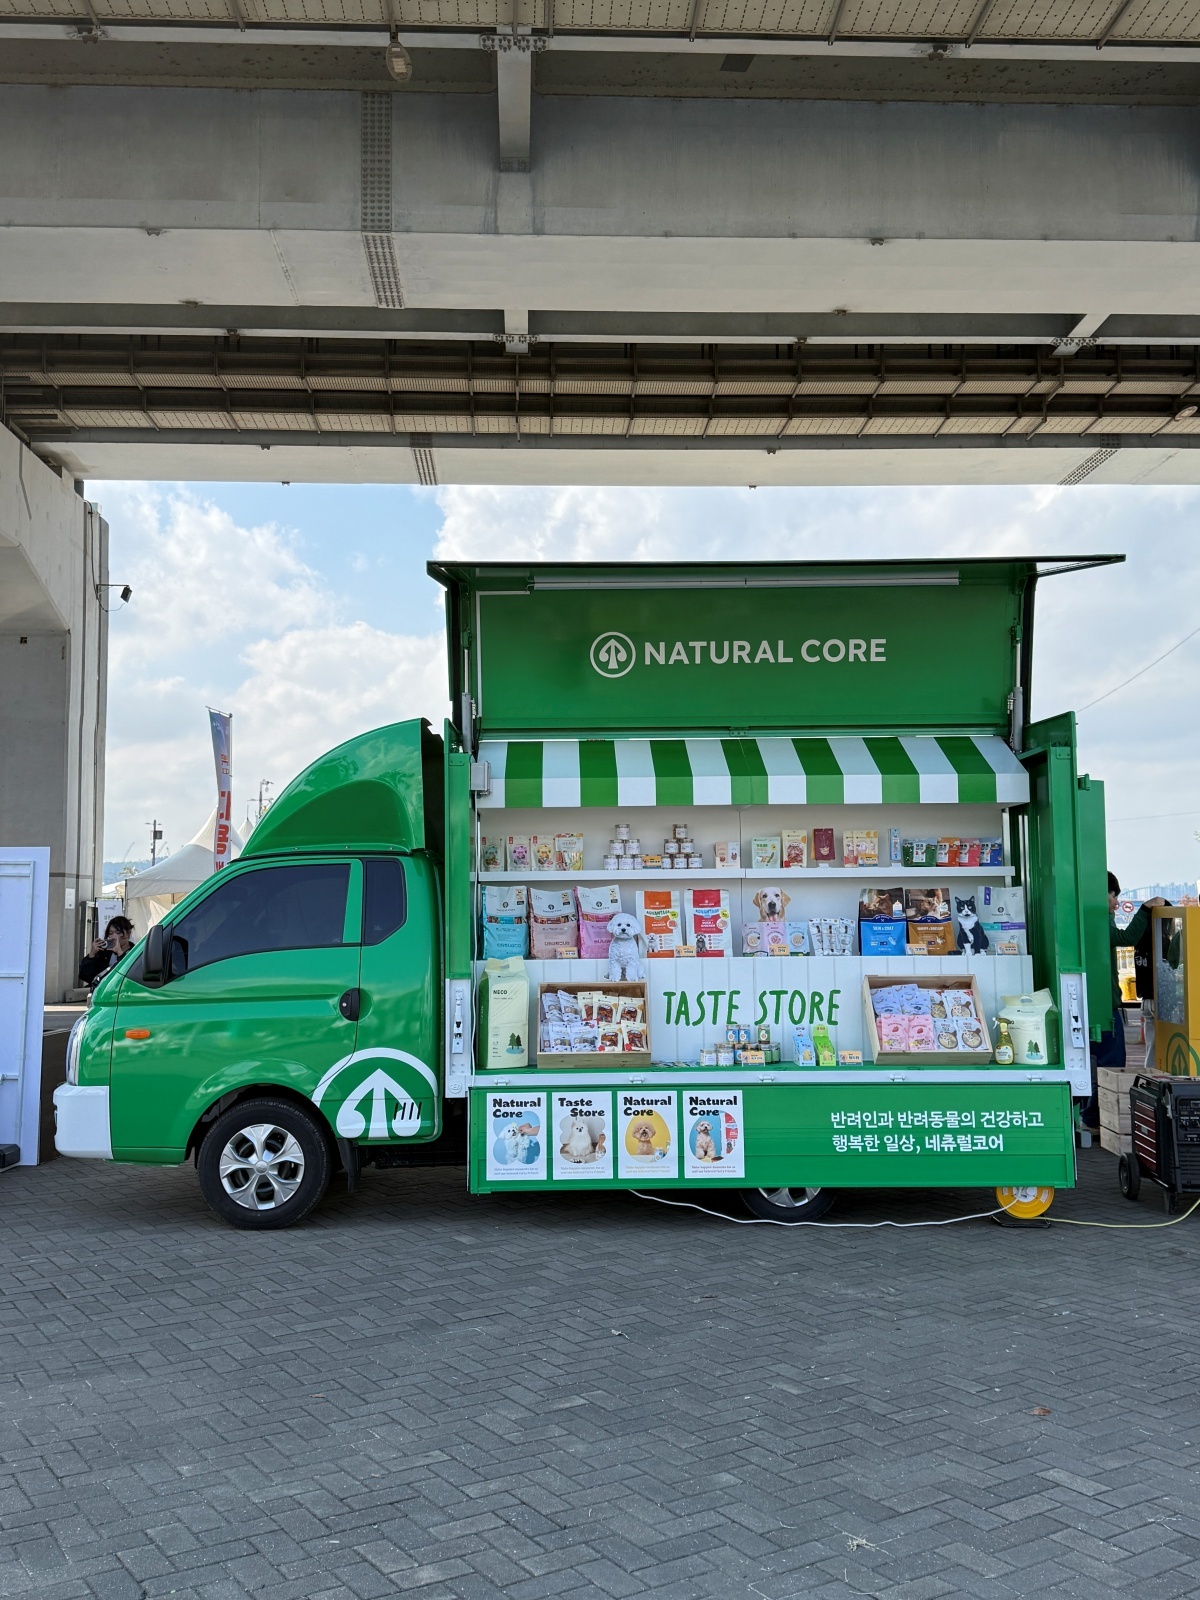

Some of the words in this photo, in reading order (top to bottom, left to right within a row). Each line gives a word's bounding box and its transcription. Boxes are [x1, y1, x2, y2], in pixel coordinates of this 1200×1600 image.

[644, 640, 794, 665] NATURAL
[800, 638, 887, 662] CORE
[662, 990, 741, 1026] TASTE
[754, 989, 842, 1026] STORE
[492, 1097, 542, 1108] Natural
[558, 1097, 593, 1107] Taste
[623, 1096, 672, 1106] Natural
[689, 1095, 738, 1106] Natural
[492, 1109, 523, 1118] Core
[570, 1107, 606, 1117] Store
[623, 1107, 654, 1117] Core
[689, 1107, 720, 1117] Core
[831, 1110, 894, 1129] 반려인과
[897, 1110, 976, 1129] 반려동물의
[980, 1110, 1044, 1128] 건강하고
[832, 1134, 880, 1152] 행복한
[883, 1134, 921, 1154] 일상,
[924, 1133, 1004, 1152] 네츄럴코어
